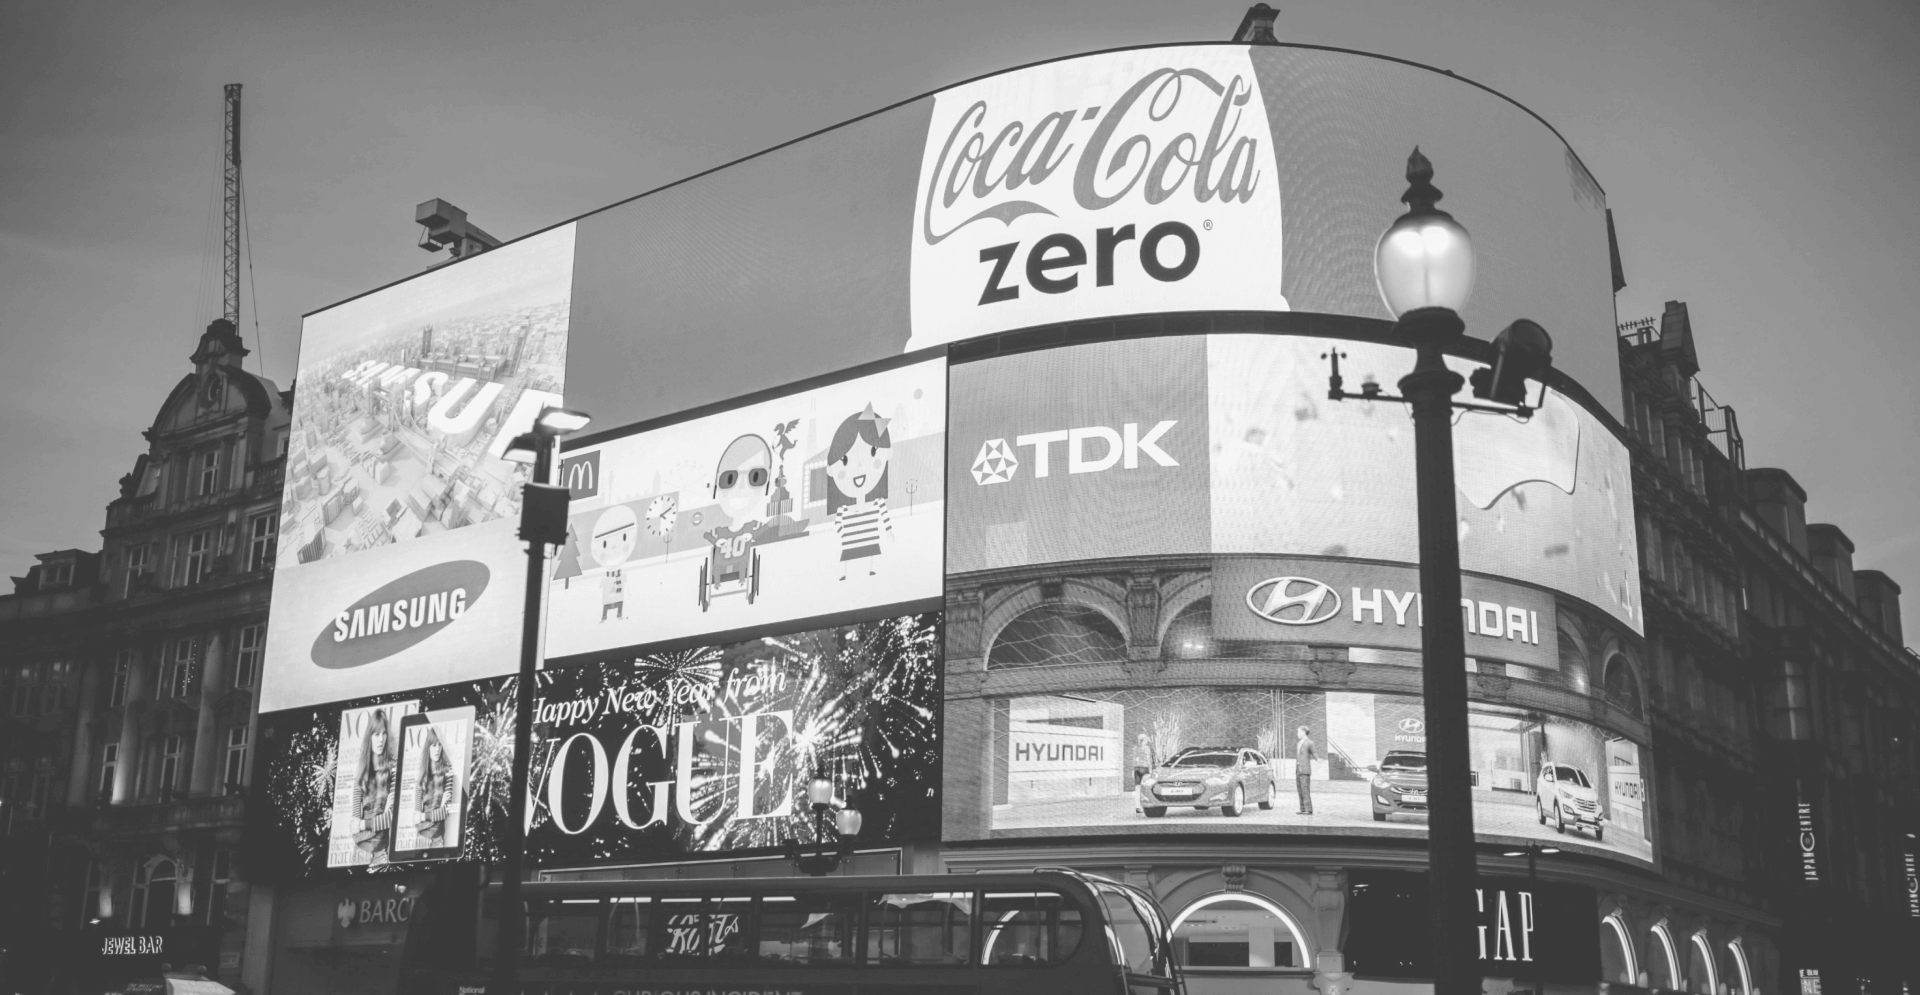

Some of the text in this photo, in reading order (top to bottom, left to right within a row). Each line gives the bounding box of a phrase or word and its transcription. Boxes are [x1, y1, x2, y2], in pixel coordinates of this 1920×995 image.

[923, 67, 1261, 245] Coca-Cola
[977, 220, 1201, 306] zero
[1016, 420, 1181, 479] TDK
[718, 536, 752, 561] 40
[333, 588, 467, 642] SAMSUNG
[1351, 586, 1539, 645] HYNDAI
[602, 685, 656, 715] New
[665, 678, 719, 707] Year
[720, 666, 787, 704] from
[1015, 742, 1104, 761] HYUNDAI
[1798, 803, 1819, 881] JAPAN CENTRE
[102, 935, 163, 955] JEWEL BAR
